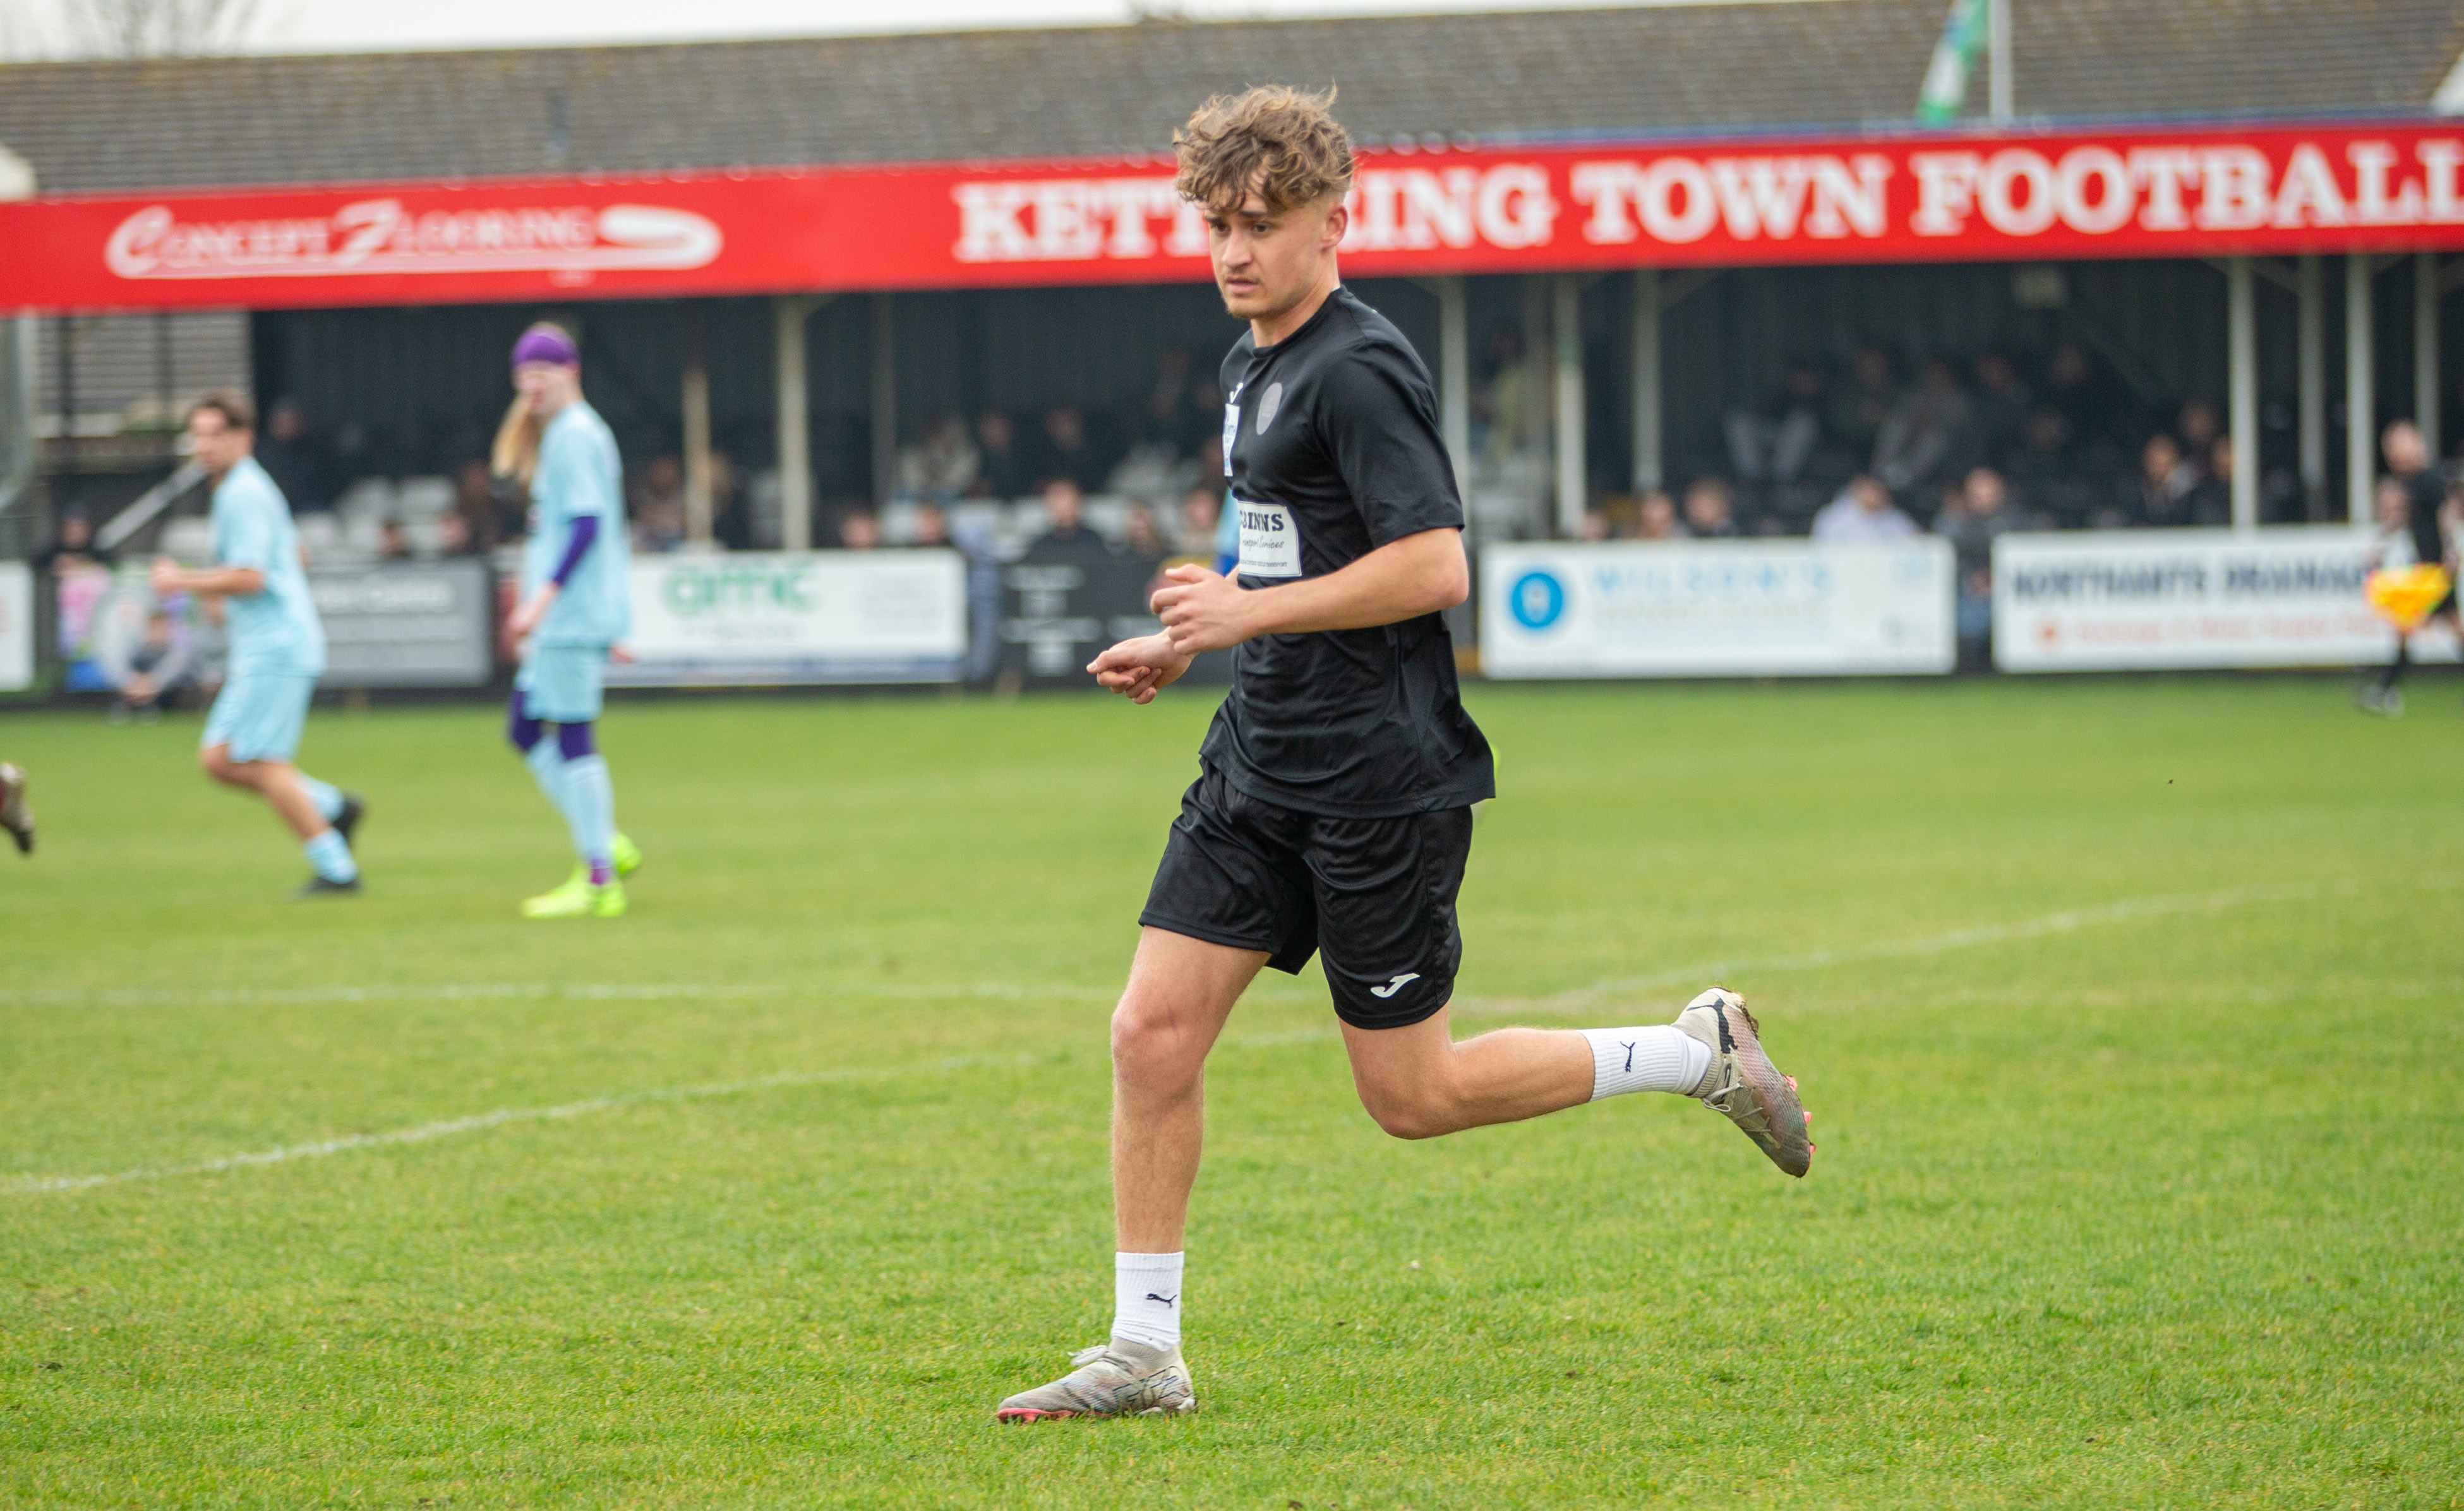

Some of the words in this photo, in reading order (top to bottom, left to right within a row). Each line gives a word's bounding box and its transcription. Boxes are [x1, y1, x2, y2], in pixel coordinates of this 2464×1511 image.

[951, 160, 1556, 263] KETTING
[1572, 153, 1890, 251] TOWN
[1908, 138, 2464, 236] FOOTBALL
